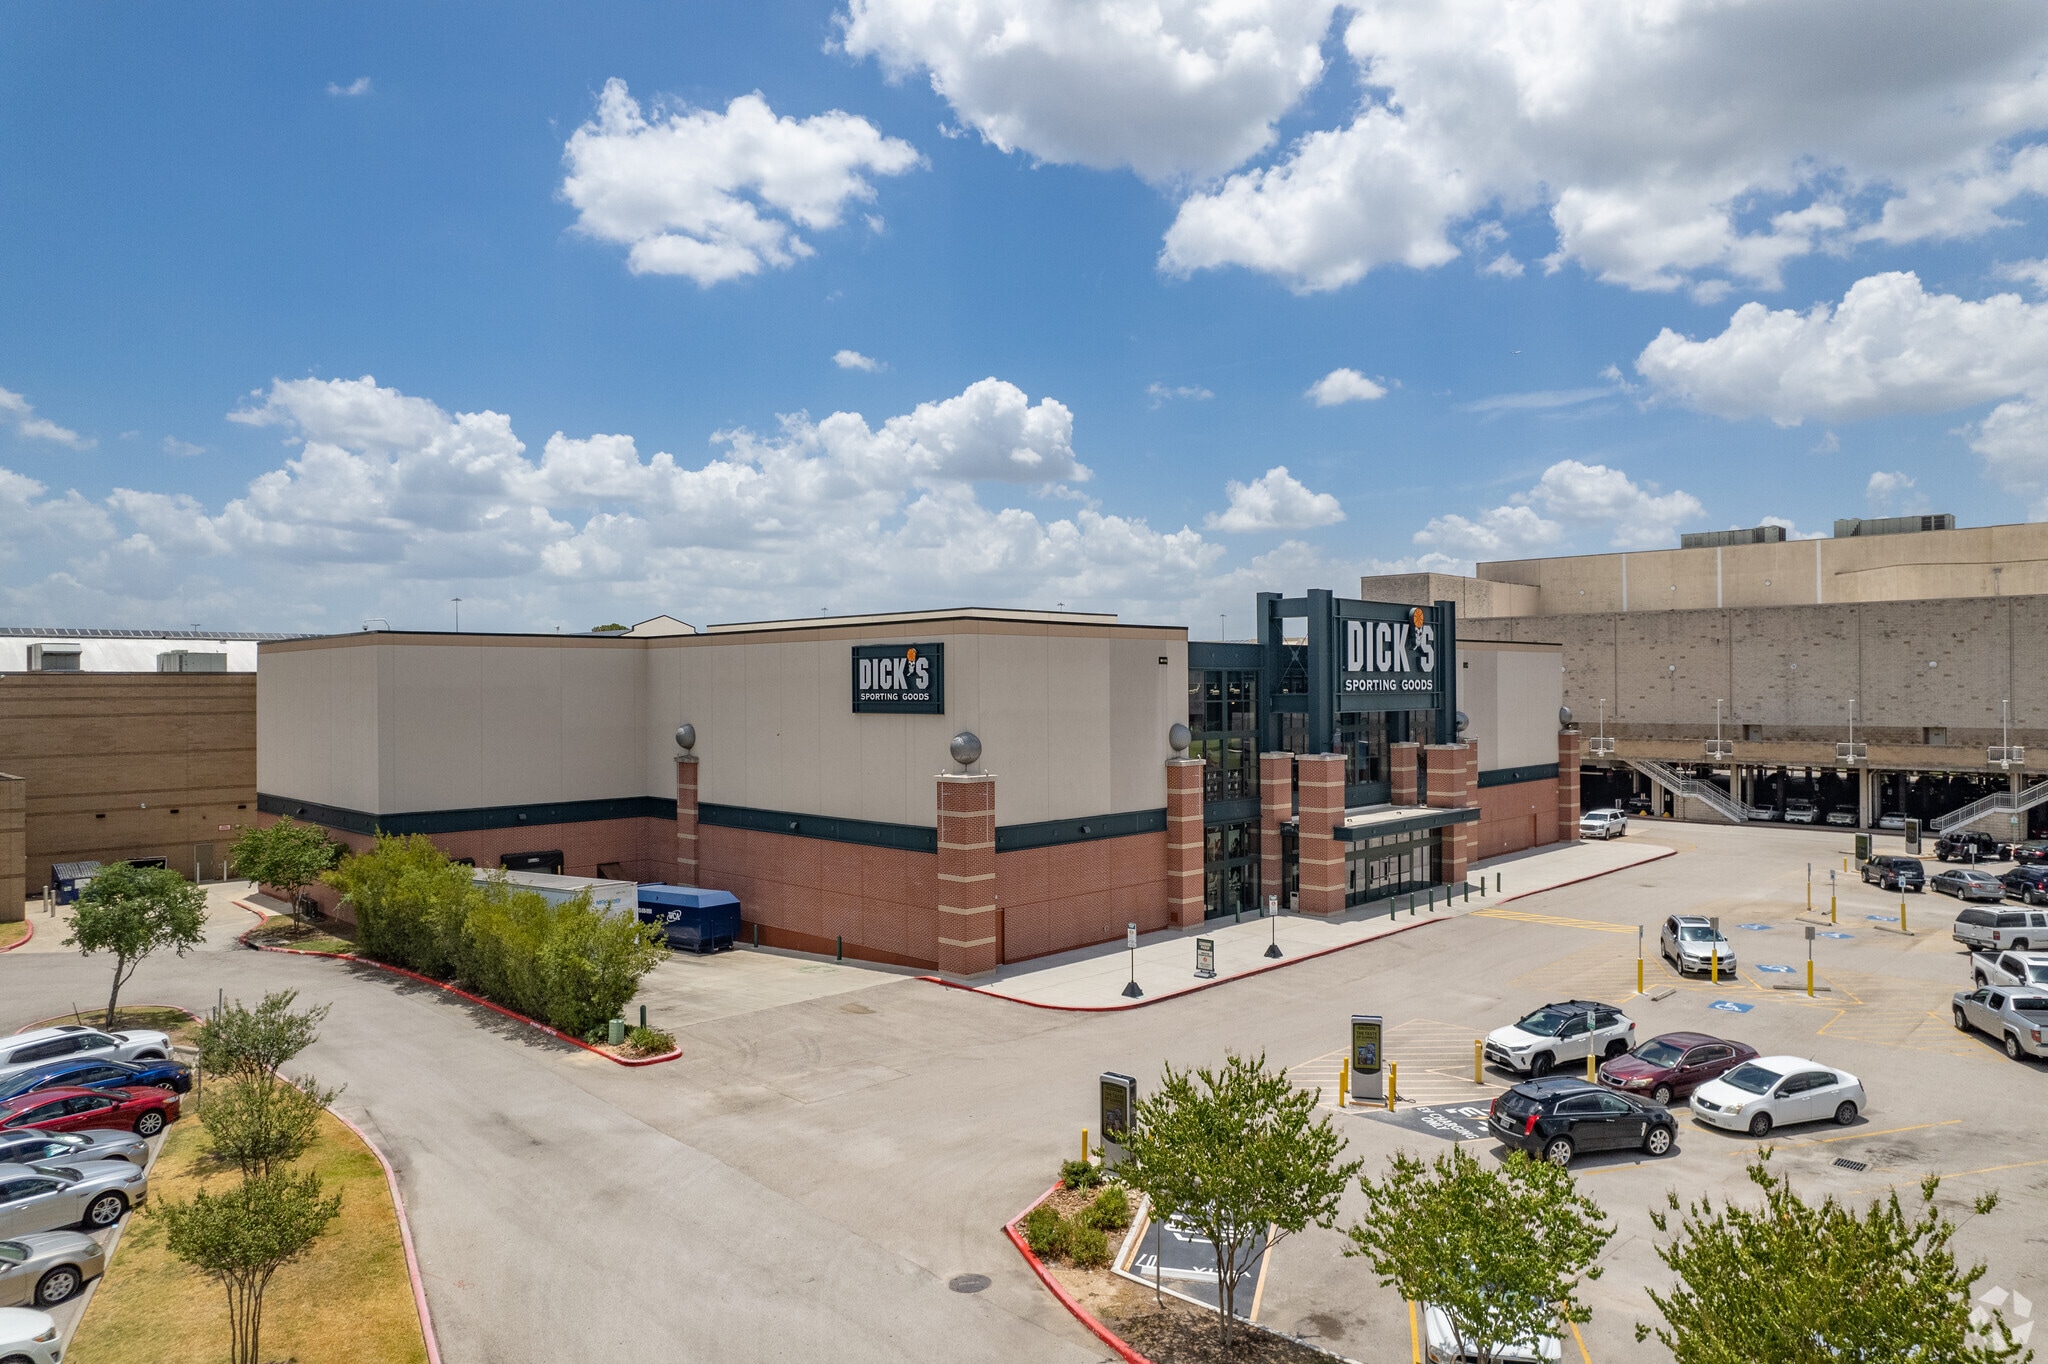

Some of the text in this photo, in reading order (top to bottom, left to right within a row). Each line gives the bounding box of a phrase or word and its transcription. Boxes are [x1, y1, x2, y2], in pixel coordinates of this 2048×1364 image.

[1347, 617, 1435, 673] DICK'S
[859, 655, 929, 690] DICK'S
[1345, 679, 1433, 691] SPORTING GOODS
[860, 693, 930, 701] SPORTING GOODS
[1421, 1116, 1450, 1130] ONLY
[1429, 1113, 1480, 1139] CHARGING
